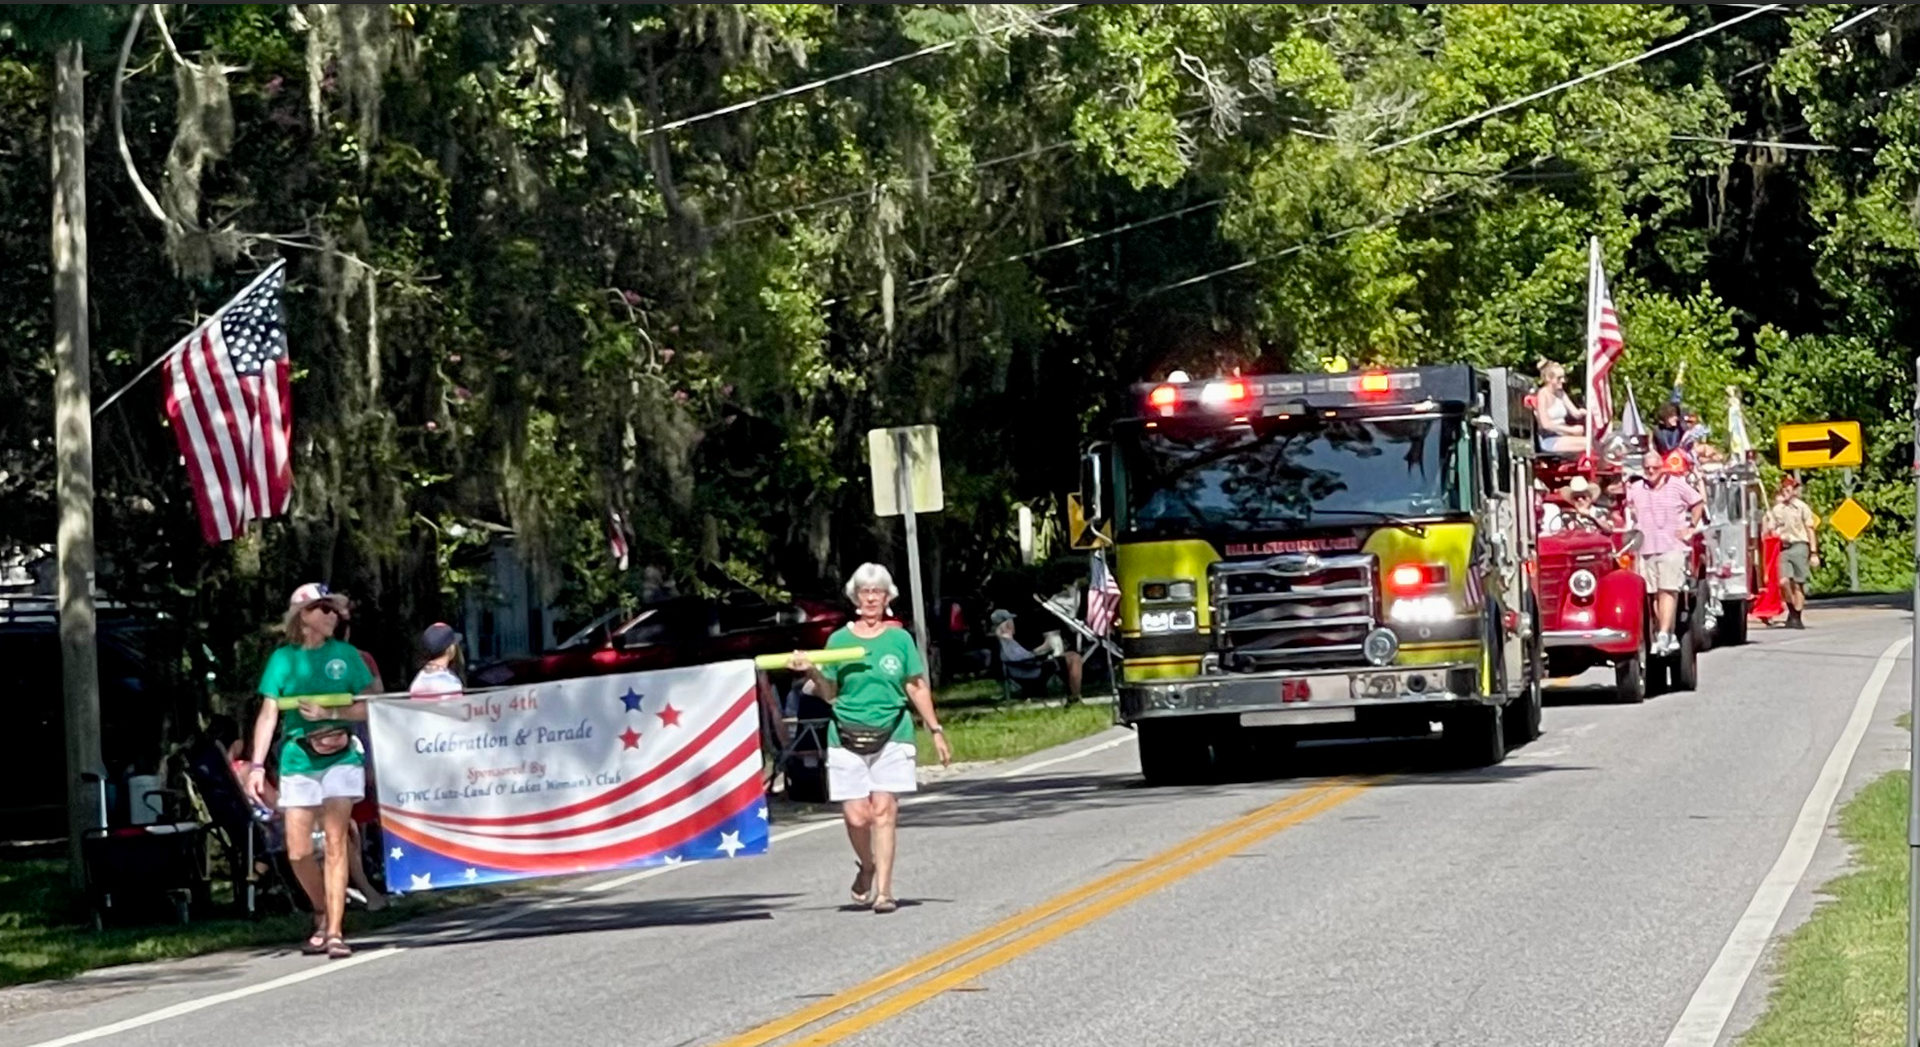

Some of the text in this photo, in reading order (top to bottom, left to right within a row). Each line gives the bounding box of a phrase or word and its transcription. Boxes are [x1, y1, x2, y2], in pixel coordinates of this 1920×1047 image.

[462, 689, 538, 722] July 4th
[414, 717, 593, 754] Celebration & Parade
[467, 760, 547, 785] Sponsored By
[510, 780, 541, 795] Lakes
[596, 769, 622, 786] Club
